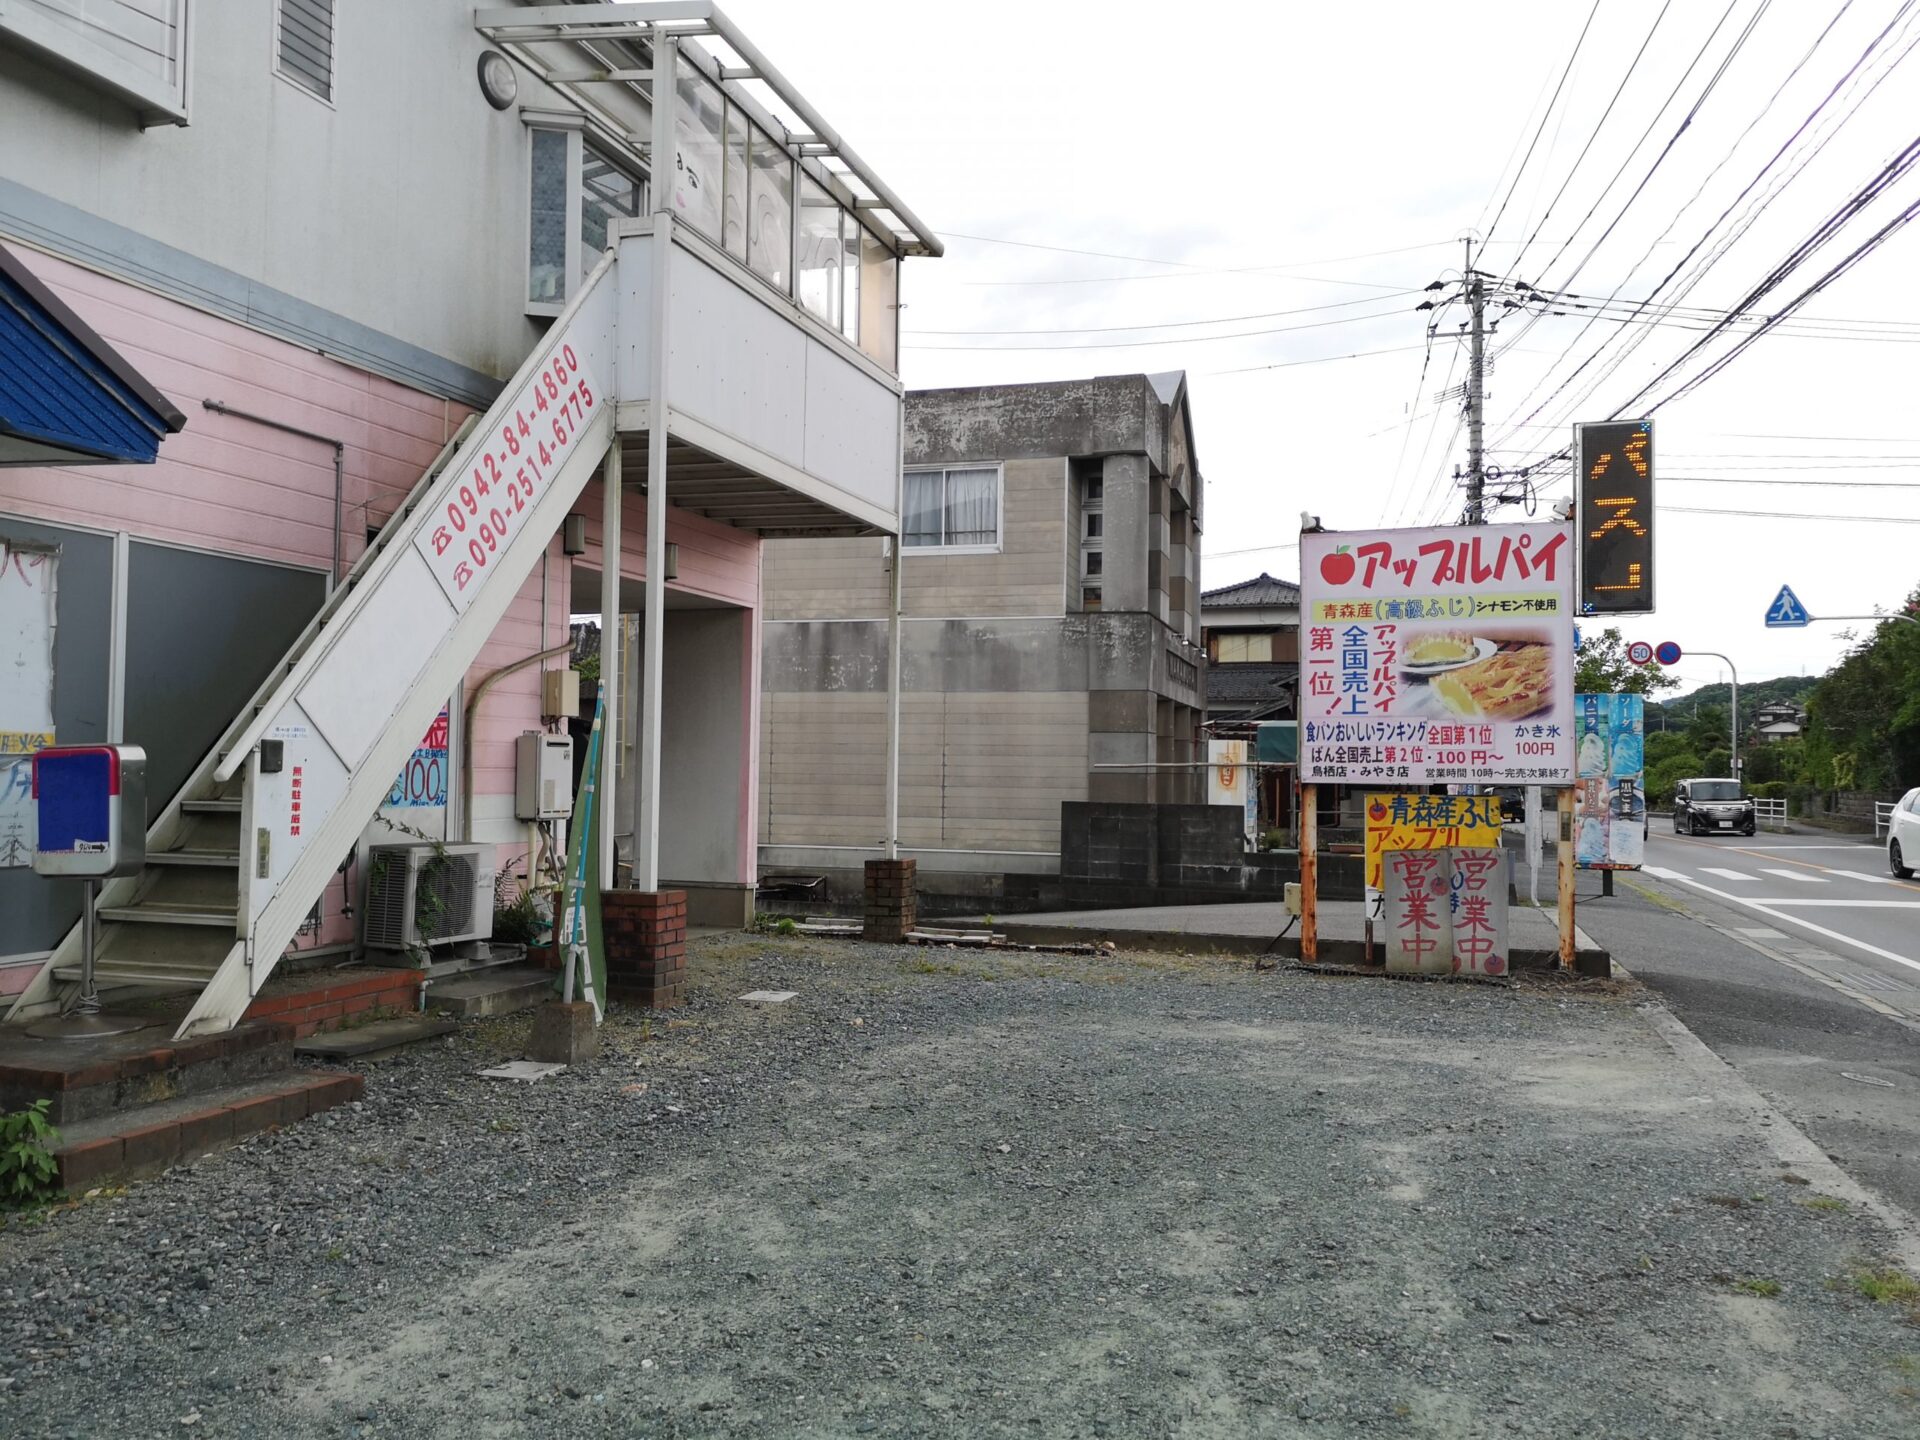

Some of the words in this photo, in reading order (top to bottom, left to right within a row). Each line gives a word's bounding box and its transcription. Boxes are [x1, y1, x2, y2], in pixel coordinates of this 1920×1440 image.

[447, 343, 578, 533] 0942-84-4860
[468, 378, 594, 567] 090-2514-6775
[1357, 532, 1567, 588] アップルパイ
[1342, 625, 1369, 716] 全国売上
[1373, 624, 1397, 713] アップルパイ
[1633, 647, 1648, 659] 50
[1515, 724, 1561, 738] かき氷
[1515, 742, 1555, 756] 100円
[1389, 795, 1501, 828] 青森産ふじ
[1620, 782, 1632, 813] 黒ごま
[1393, 852, 1440, 965] 営業中
[1453, 849, 1498, 970] 営業中
